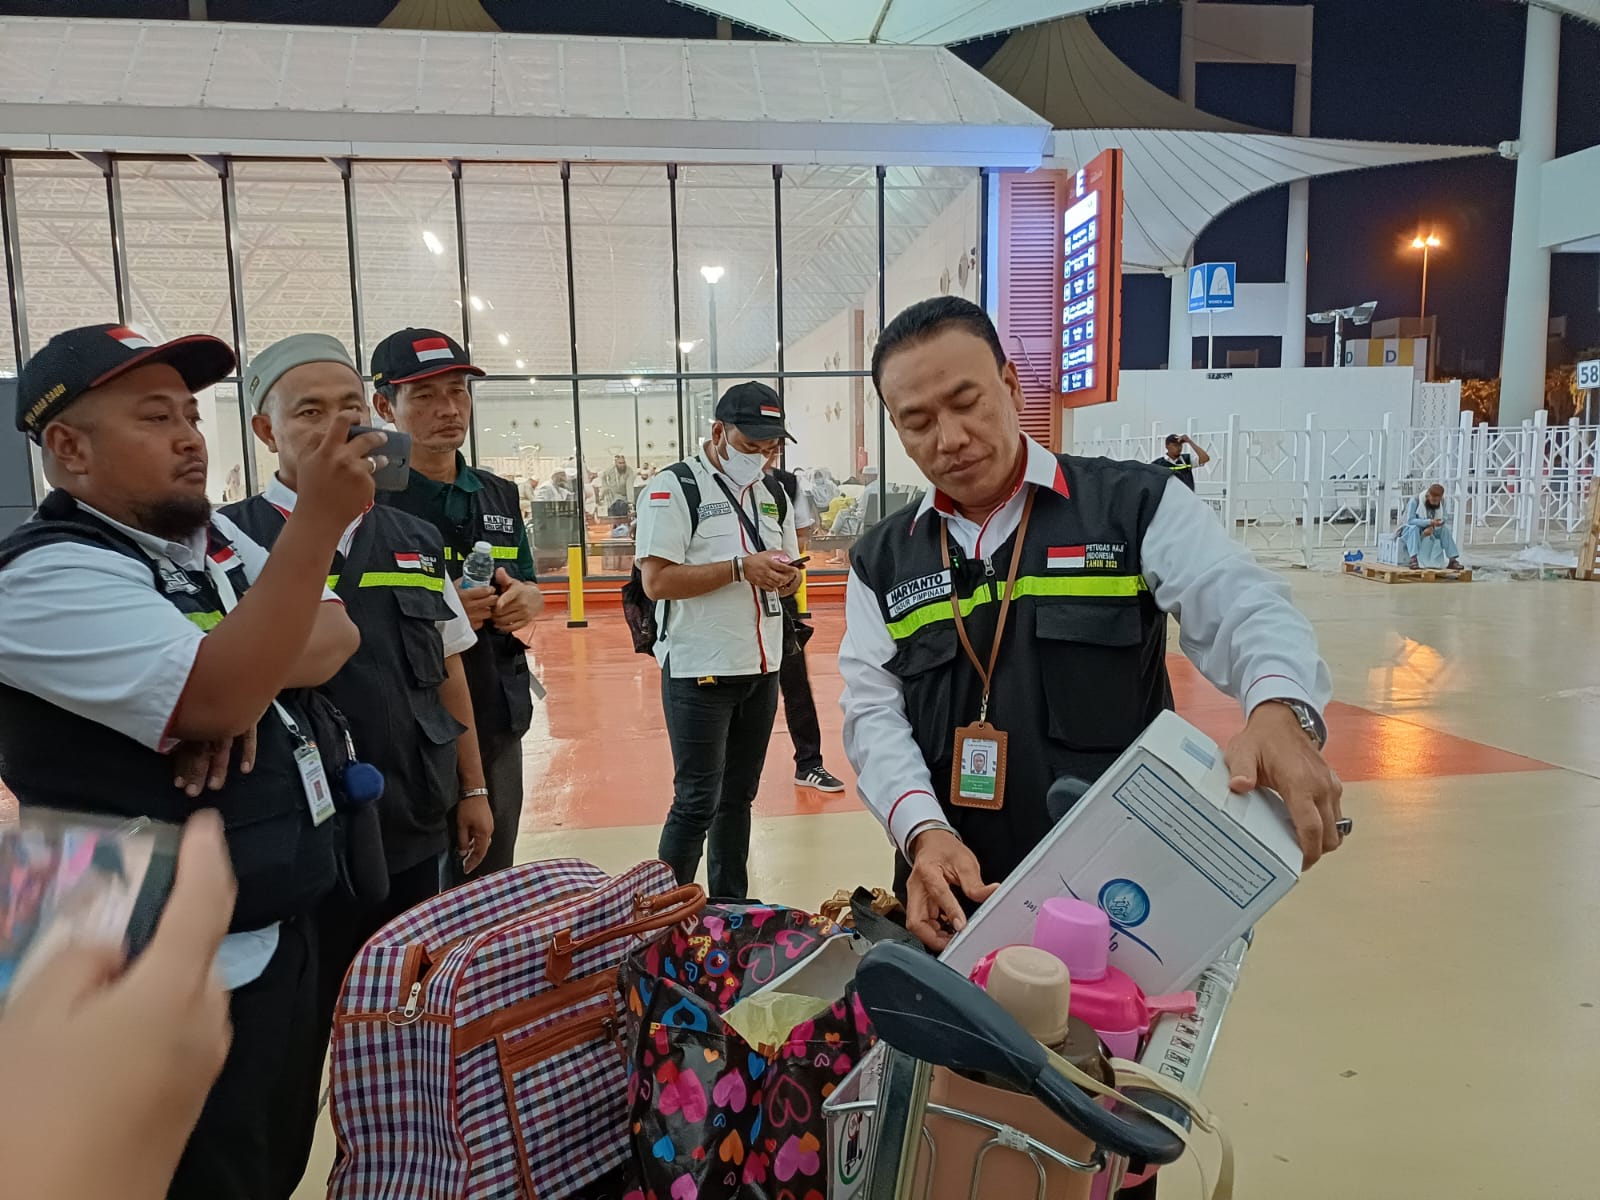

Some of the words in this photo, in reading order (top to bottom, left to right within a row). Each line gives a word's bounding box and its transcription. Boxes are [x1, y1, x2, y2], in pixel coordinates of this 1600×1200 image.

[1076, 169, 1085, 198] E
[1346, 351, 1353, 364] D
[1385, 350, 1397, 363] D
[1580, 365, 1599, 384] 58
[1085, 543, 1110, 552] PETUGAS
[1085, 551, 1115, 560] INDONESIA
[1085, 559, 1104, 568] TAHUN
[890, 573, 943, 603] HARYANTO
[894, 598, 911, 614] UNSUR
[912, 586, 945, 602] PIMPINAN
